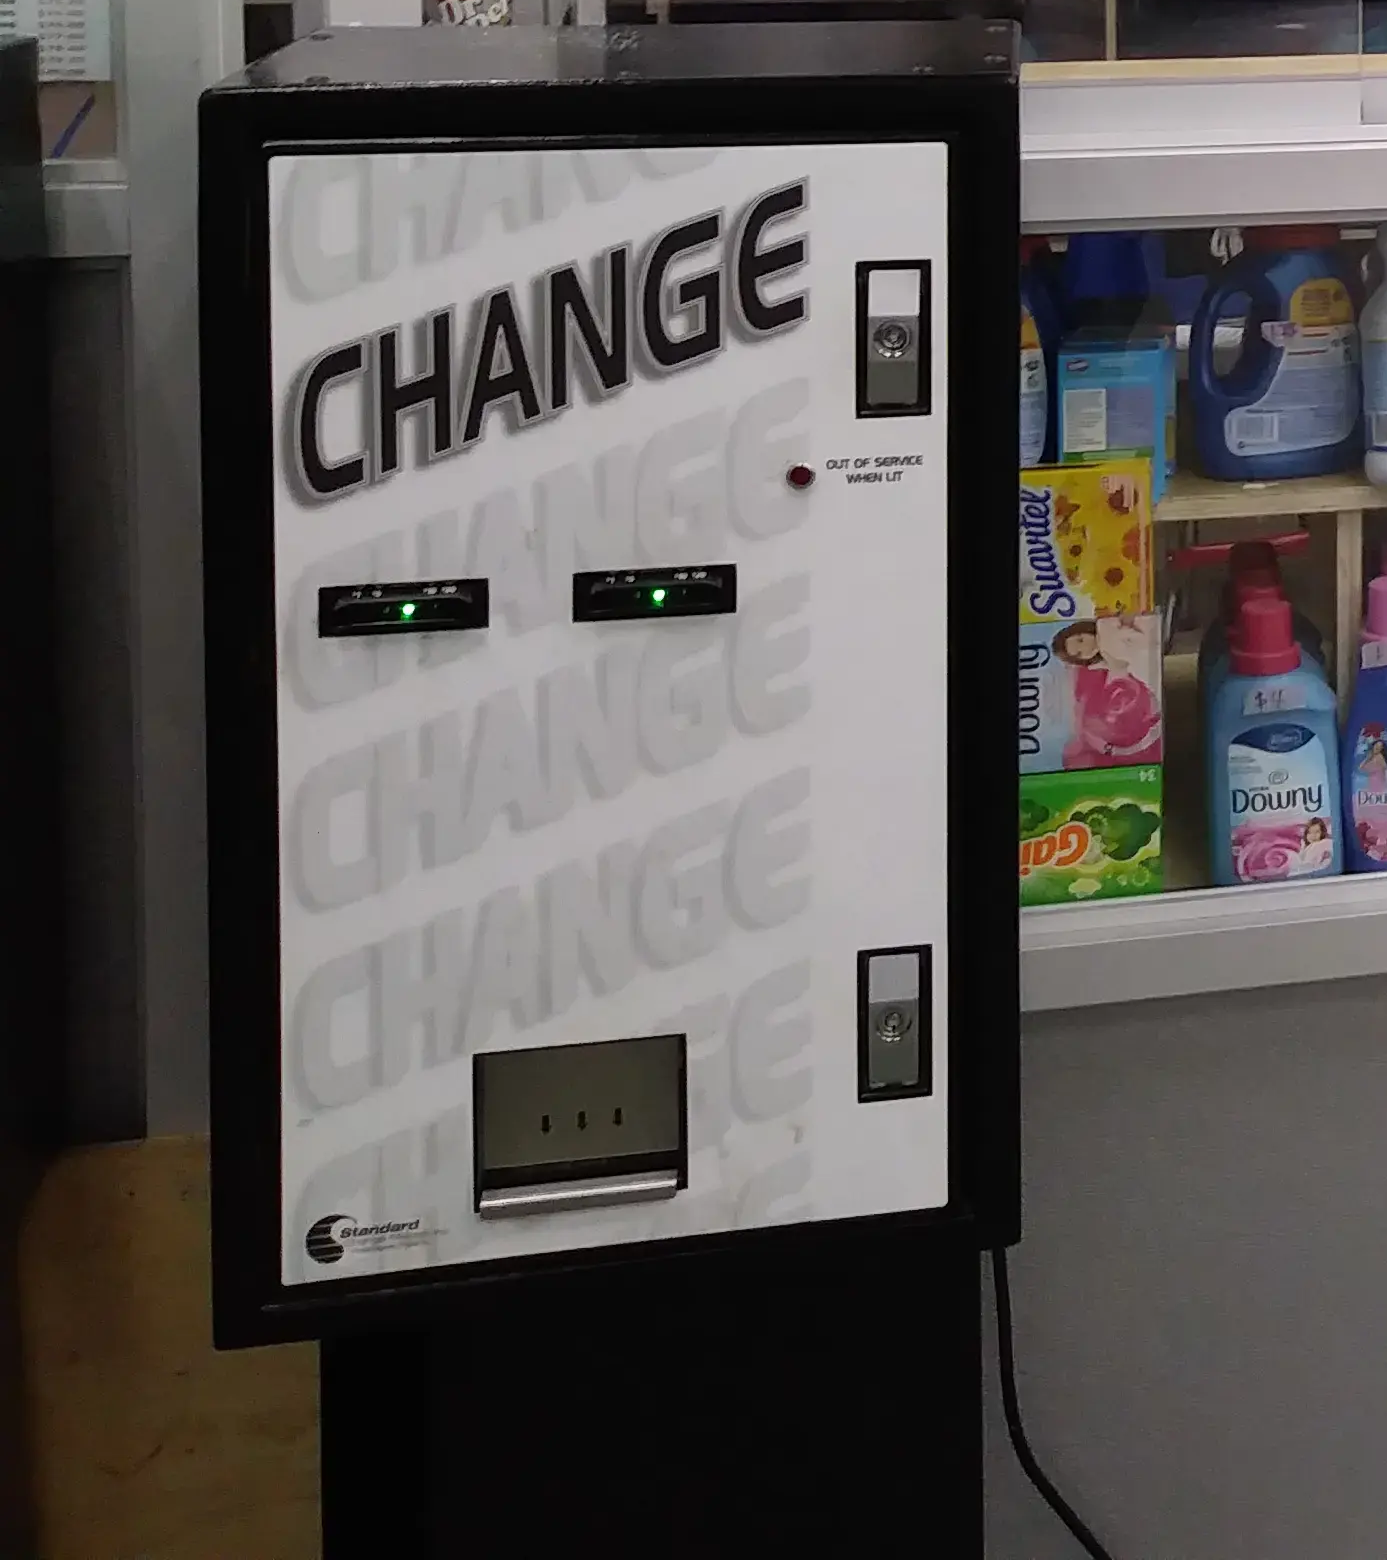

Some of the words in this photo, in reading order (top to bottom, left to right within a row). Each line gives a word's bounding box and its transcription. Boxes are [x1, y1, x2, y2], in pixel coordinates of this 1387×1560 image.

[290, 174, 811, 504] CHANGE
[826, 458, 850, 471] OUT
[853, 457, 871, 469] OF
[873, 454, 924, 468] SERVICE
[845, 472, 883, 484] WHEN
[885, 470, 904, 482] LIT
[1021, 487, 1077, 619] Suavitel
[1020, 642, 1051, 756] Downy
[1231, 783, 1324, 815] Downy
[339, 1218, 421, 1239] Standard
